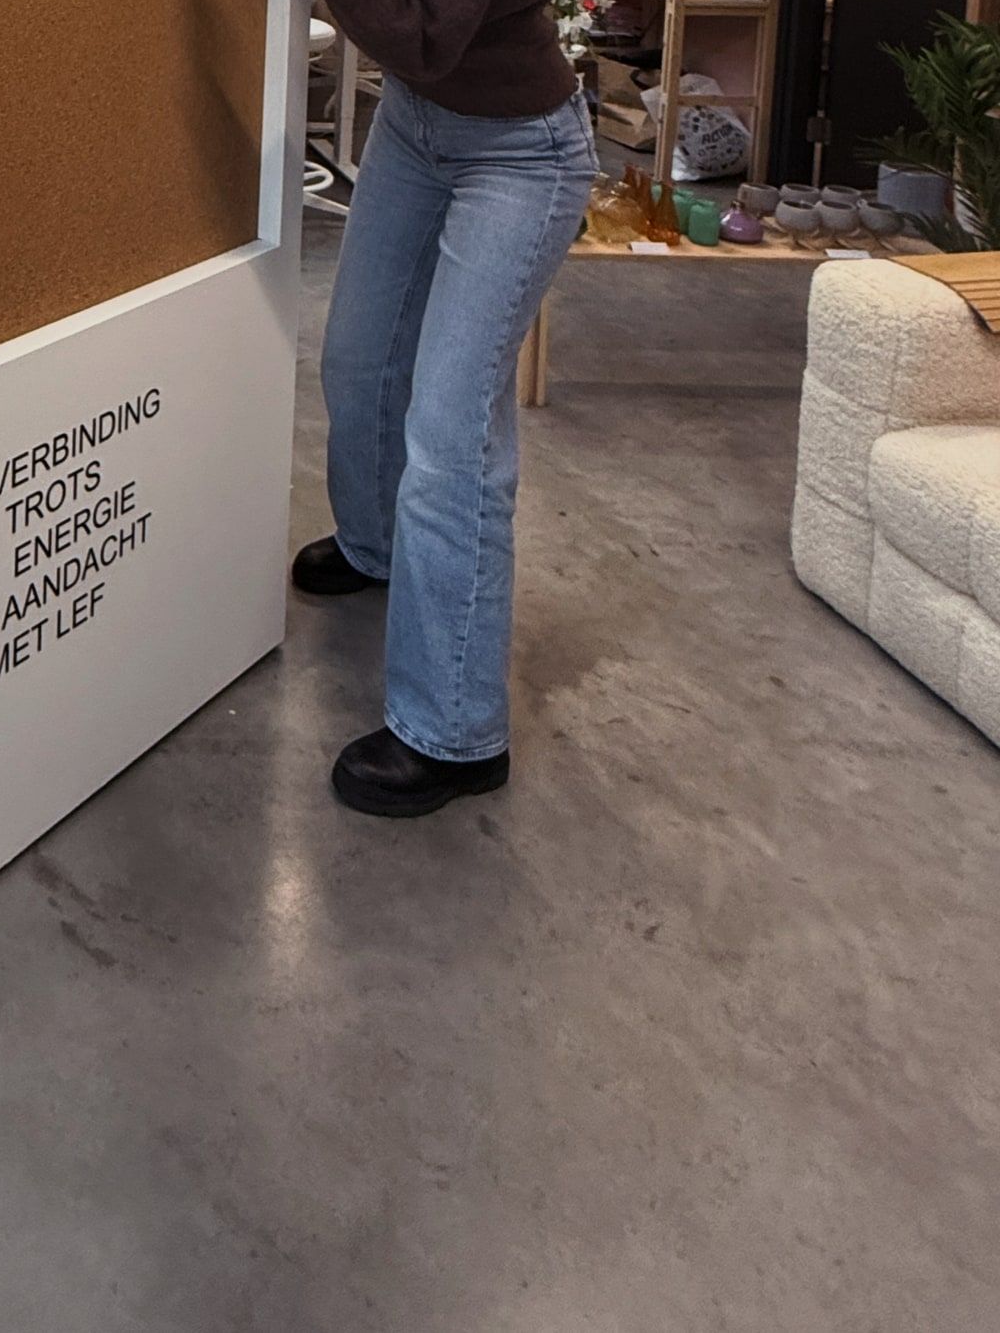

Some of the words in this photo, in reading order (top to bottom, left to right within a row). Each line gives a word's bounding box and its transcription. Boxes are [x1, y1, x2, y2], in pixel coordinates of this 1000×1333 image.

[5, 460, 102, 534] TROTS
[14, 481, 136, 578] ENERGIE
[1, 512, 152, 631] AANDACHT
[56, 582, 106, 640] LEF
